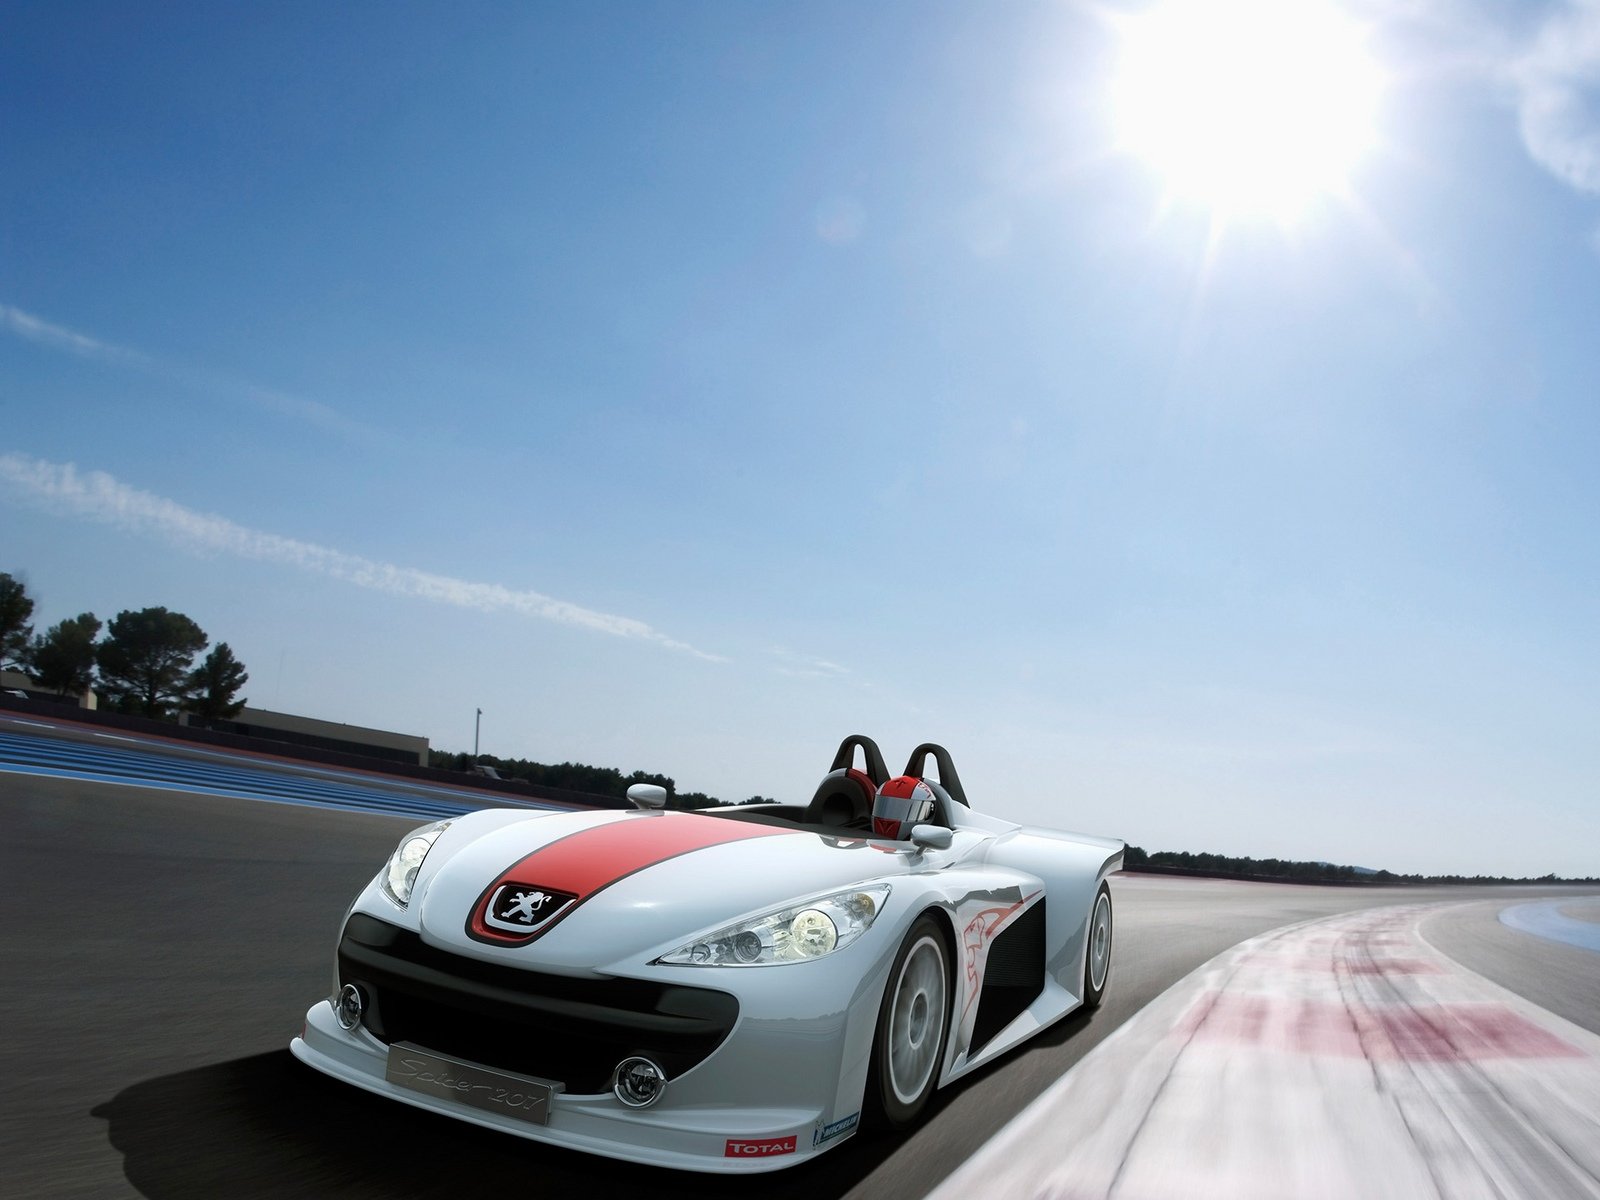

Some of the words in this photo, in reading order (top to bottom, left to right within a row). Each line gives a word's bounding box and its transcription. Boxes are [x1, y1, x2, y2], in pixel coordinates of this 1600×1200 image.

[390, 1059, 492, 1092] Spider
[488, 1088, 545, 1110] 207
[823, 1115, 857, 1138] MICHELIN
[729, 1142, 794, 1154] TOTAL
